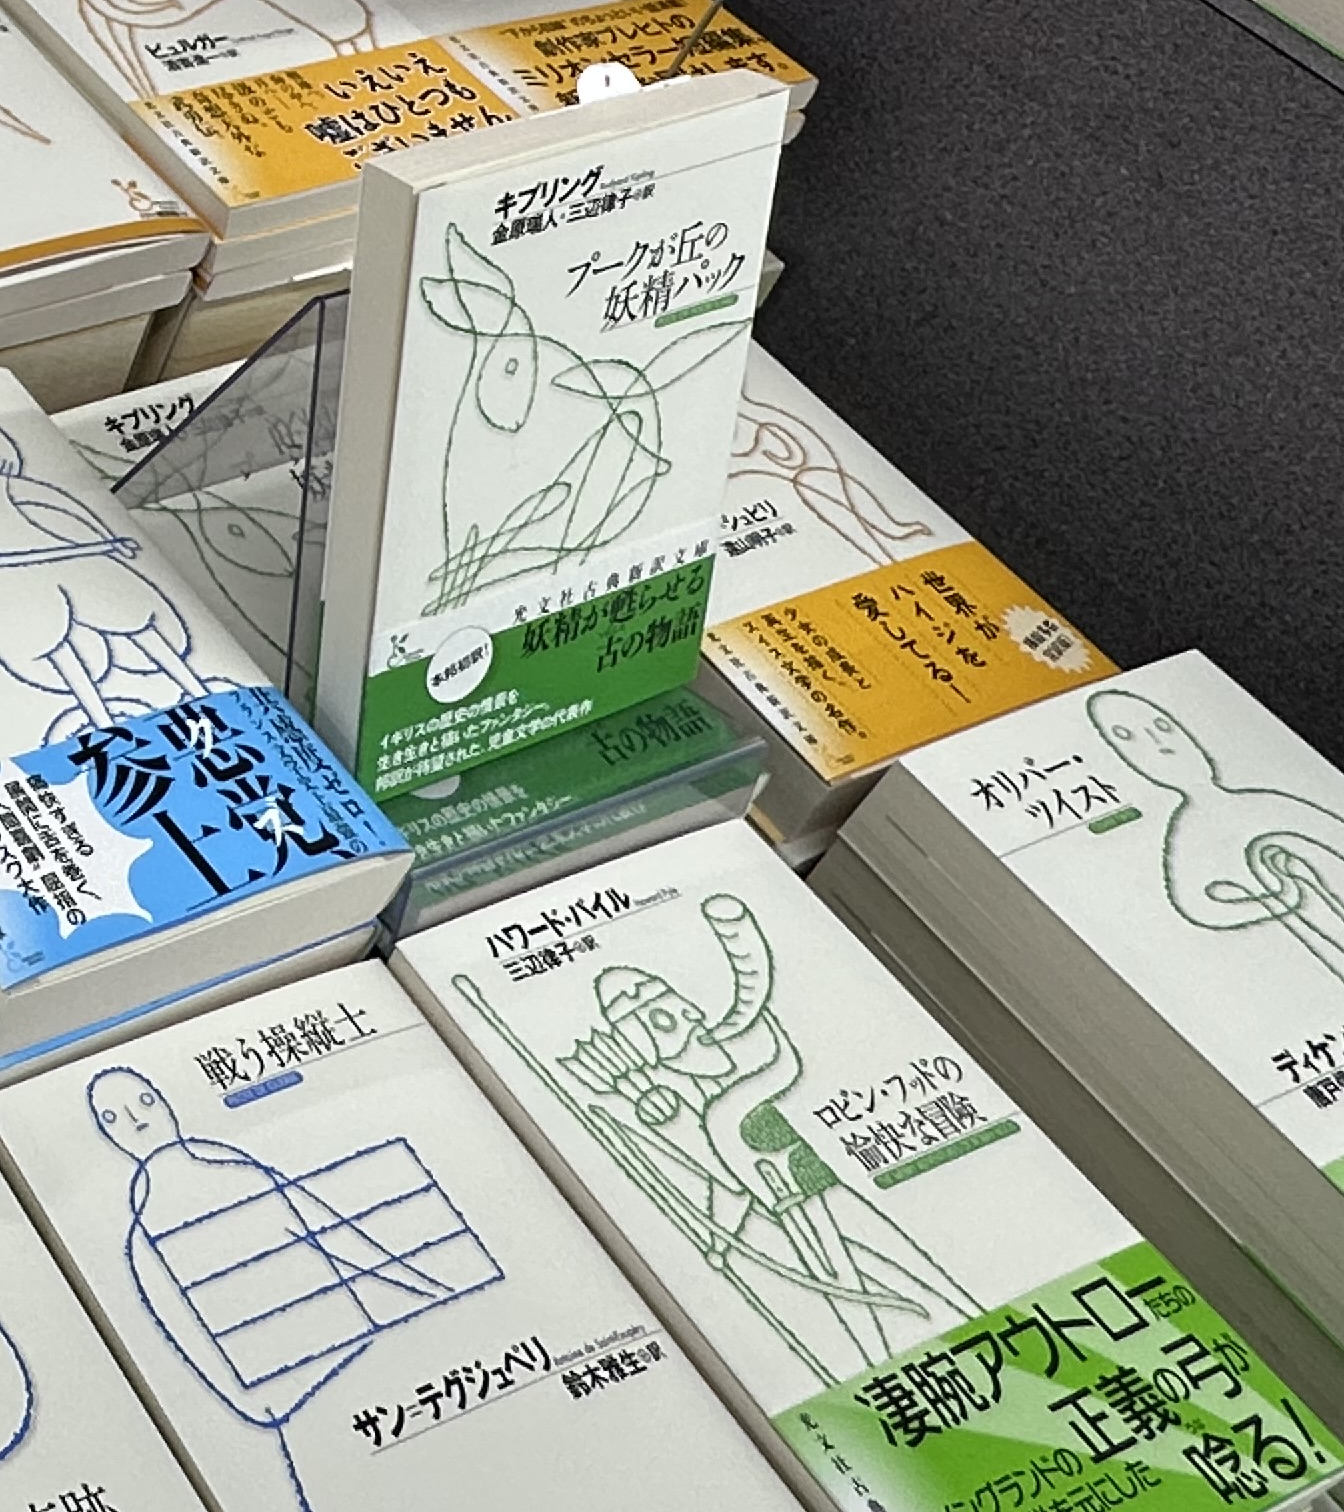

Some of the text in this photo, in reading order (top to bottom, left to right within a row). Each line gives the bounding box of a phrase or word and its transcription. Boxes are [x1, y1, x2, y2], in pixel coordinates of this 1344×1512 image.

[304, 77, 479, 146] 嘘はひとつも
[324, 51, 450, 102] いえいえ
[494, 165, 605, 220] キプリング
[565, 220, 730, 298] プークが丘の
[599, 252, 747, 332] 妖精パック
[596, 604, 700, 674] 古の物語
[889, 583, 987, 669] ハイジを
[67, 726, 266, 912] 参上
[1026, 775, 1121, 830] ツイスト
[484, 886, 634, 958] ハワード・パイル
[193, 1001, 378, 1092] 戦う操縦士
[1271, 1024, 1344, 1083] ディケ
[812, 1054, 966, 1130] ロビン・フッドの
[837, 1092, 991, 1174] 愉快な冒険
[853, 1275, 1167, 1449] 凄腕アウトロー
